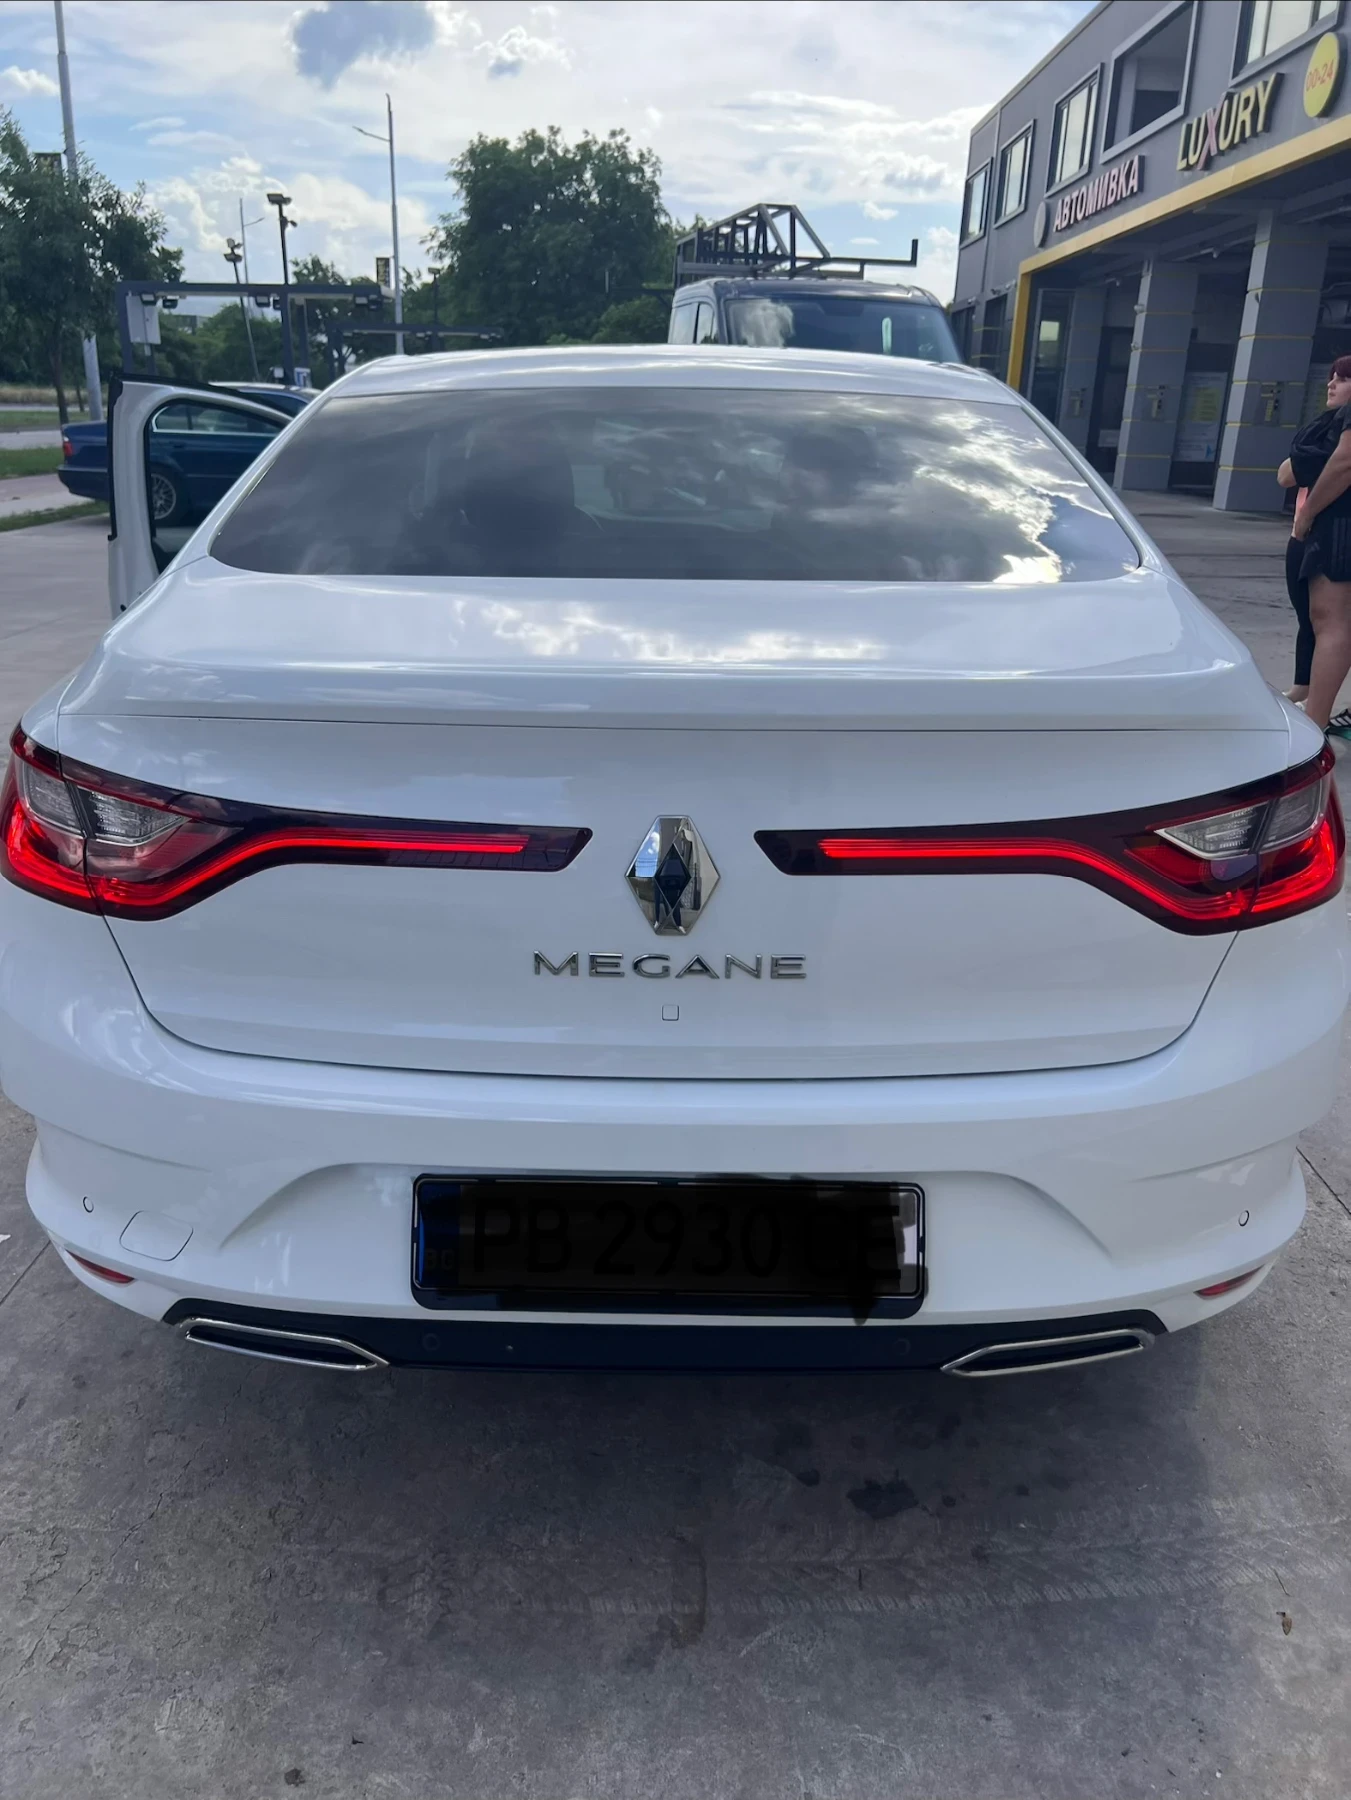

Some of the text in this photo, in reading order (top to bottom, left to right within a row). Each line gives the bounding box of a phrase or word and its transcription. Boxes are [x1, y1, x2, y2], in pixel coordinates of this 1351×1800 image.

[1176, 72, 1281, 171] LUXURY
[1053, 155, 1140, 233] АВТОМИВКА
[533, 950, 806, 979] MEGANE
